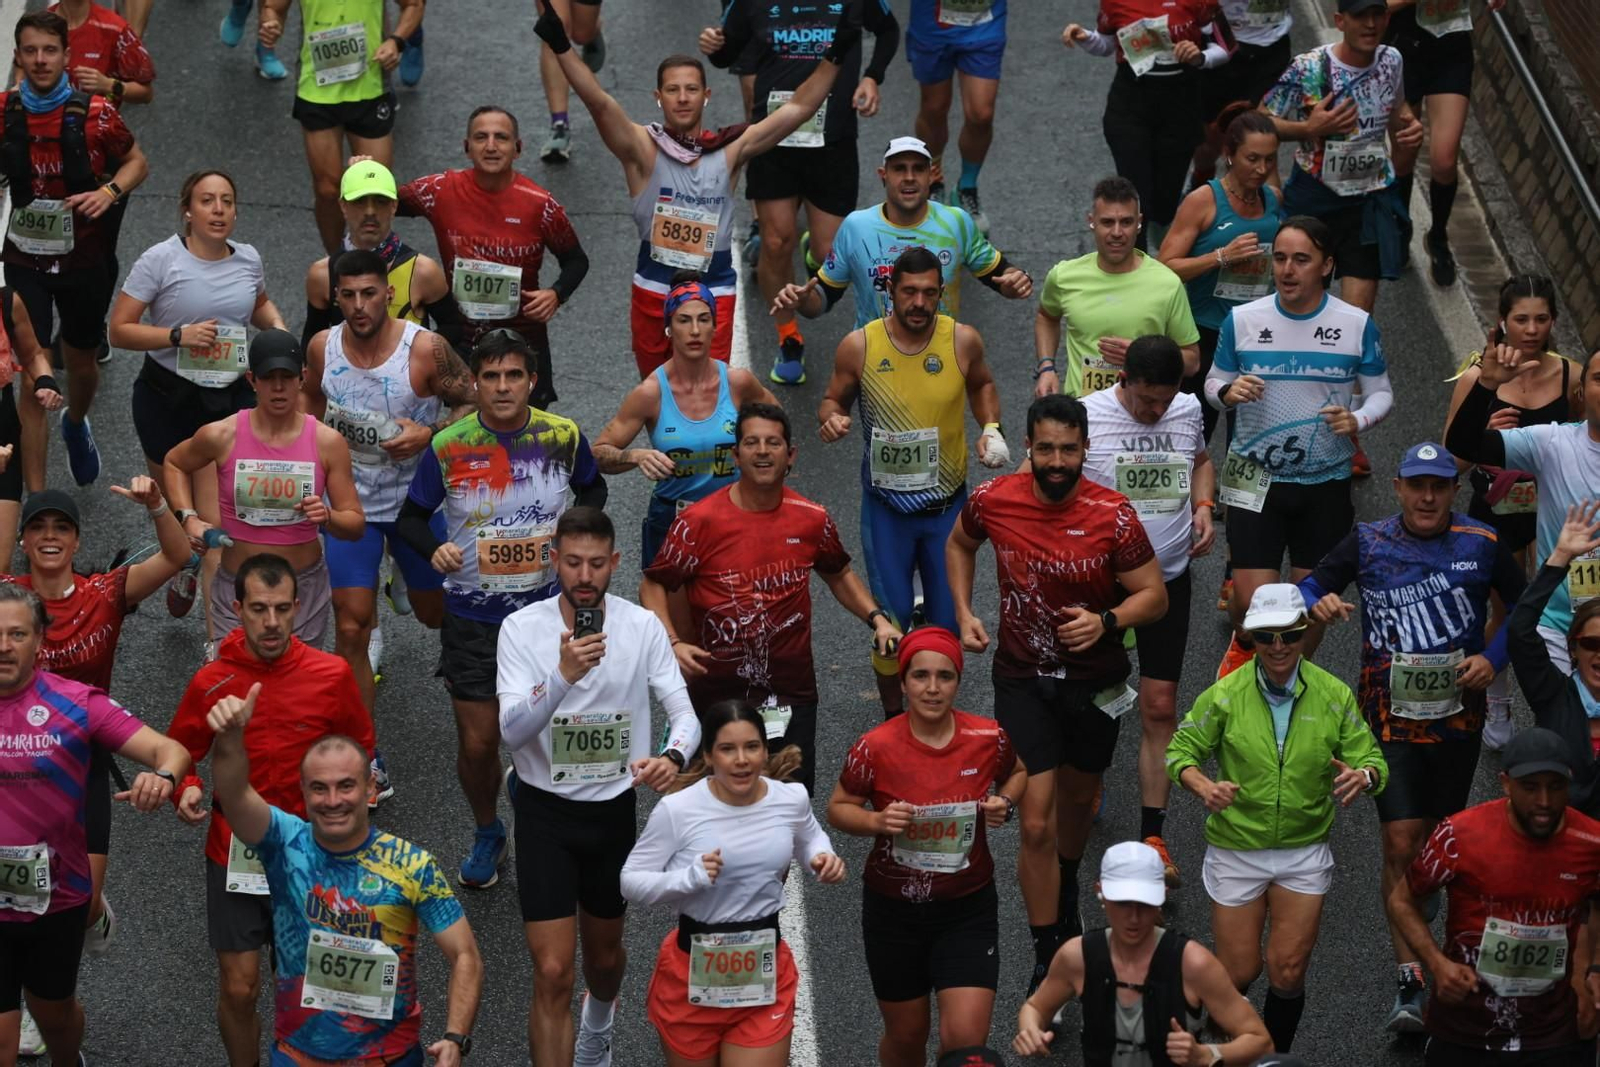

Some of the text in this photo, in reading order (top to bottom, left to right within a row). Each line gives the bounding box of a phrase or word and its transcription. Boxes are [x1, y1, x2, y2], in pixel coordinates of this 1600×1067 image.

[315, 38, 359, 61] 10360
[1329, 155, 1376, 173] 17952
[675, 191, 726, 206] Freyssinet
[661, 220, 702, 244] 5839
[464, 274, 505, 294] 8107
[1314, 326, 1342, 341] ACS
[328, 417, 377, 446] 16539
[880, 445, 921, 465] 6731
[247, 476, 297, 499] 7100
[1126, 468, 1172, 489] 9226
[489, 542, 536, 565] 5985
[1452, 561, 1478, 571] HOKA
[1389, 571, 1451, 605] MARATÓN
[1366, 585, 1477, 653] SEVILLA
[1401, 670, 1452, 690] 7623
[563, 729, 615, 751] 7065
[906, 821, 958, 841] 8504
[703, 950, 757, 974] 7066
[1494, 940, 1550, 967] 8162
[320, 952, 378, 982] 6577
